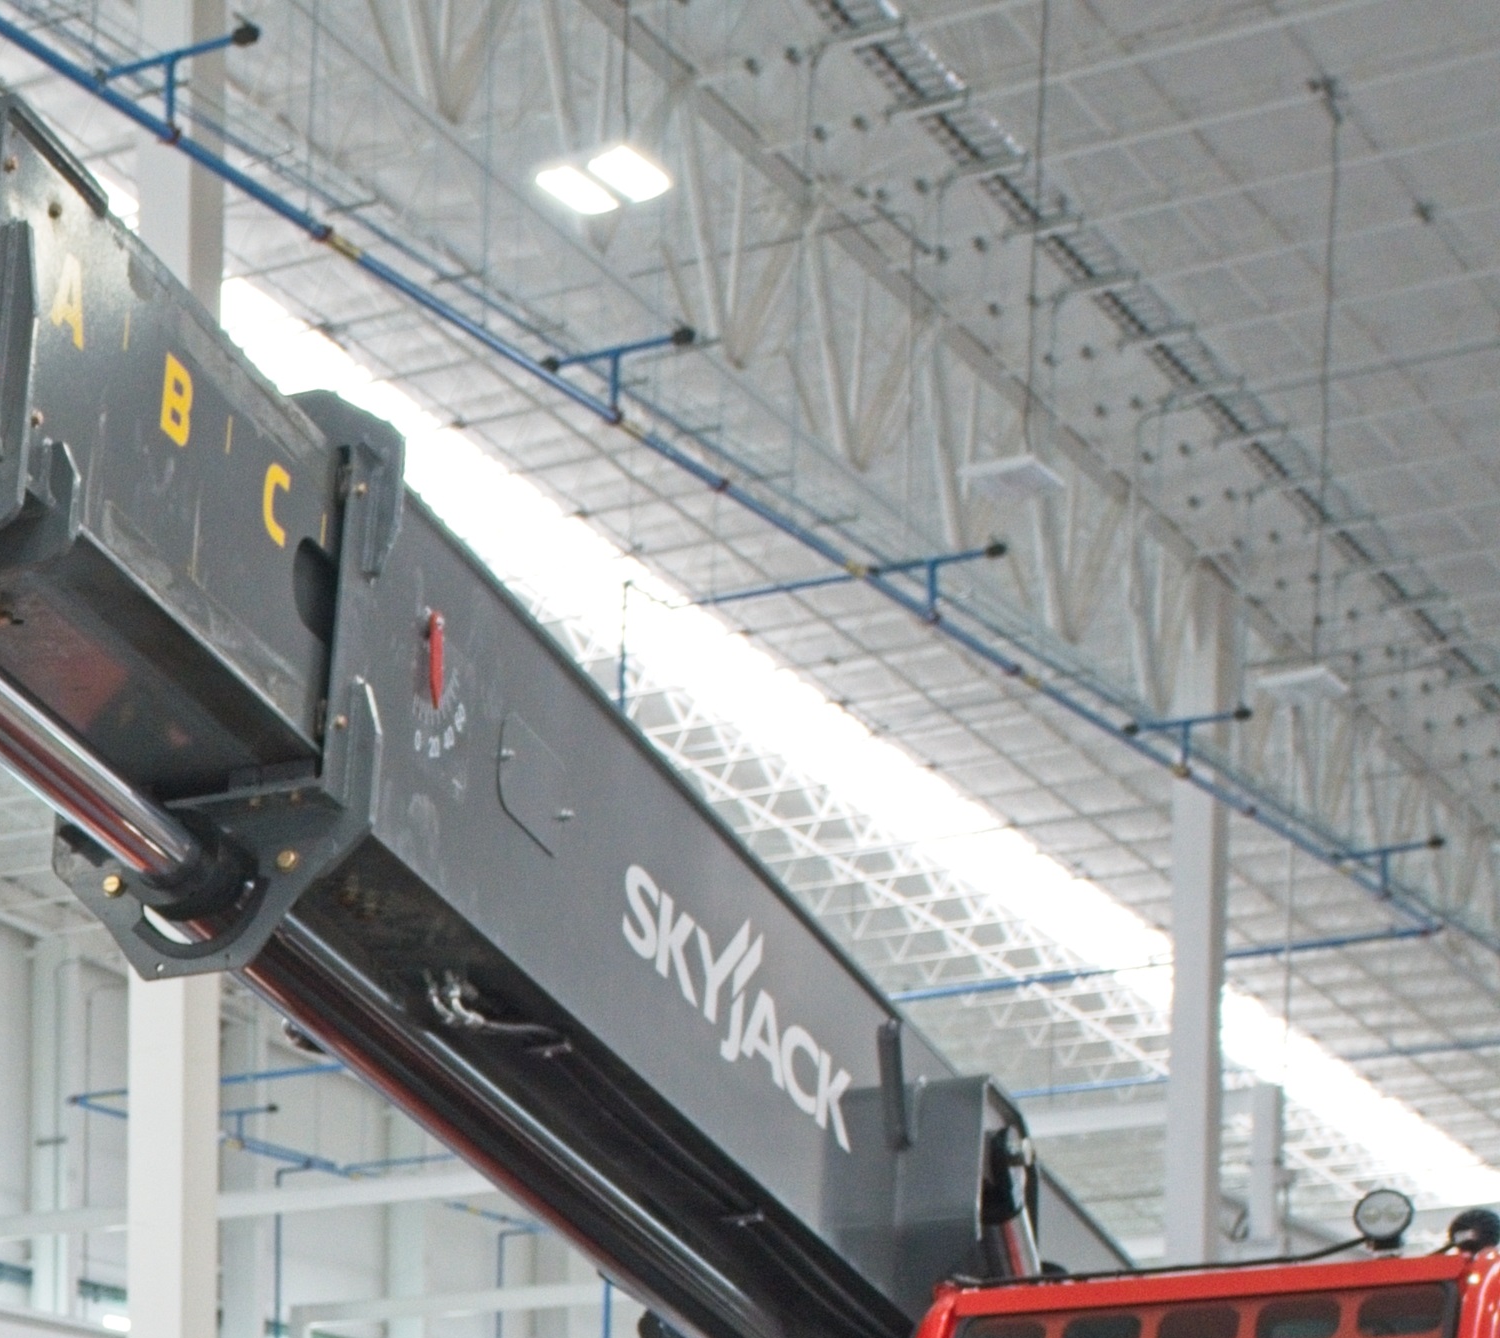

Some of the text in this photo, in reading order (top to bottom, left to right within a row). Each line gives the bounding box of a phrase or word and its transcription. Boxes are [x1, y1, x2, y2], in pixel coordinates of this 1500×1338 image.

[50, 252, 84, 351] A
[160, 351, 193, 447] B
[263, 462, 291, 548] C
[622, 864, 852, 1154] SKYJACK
